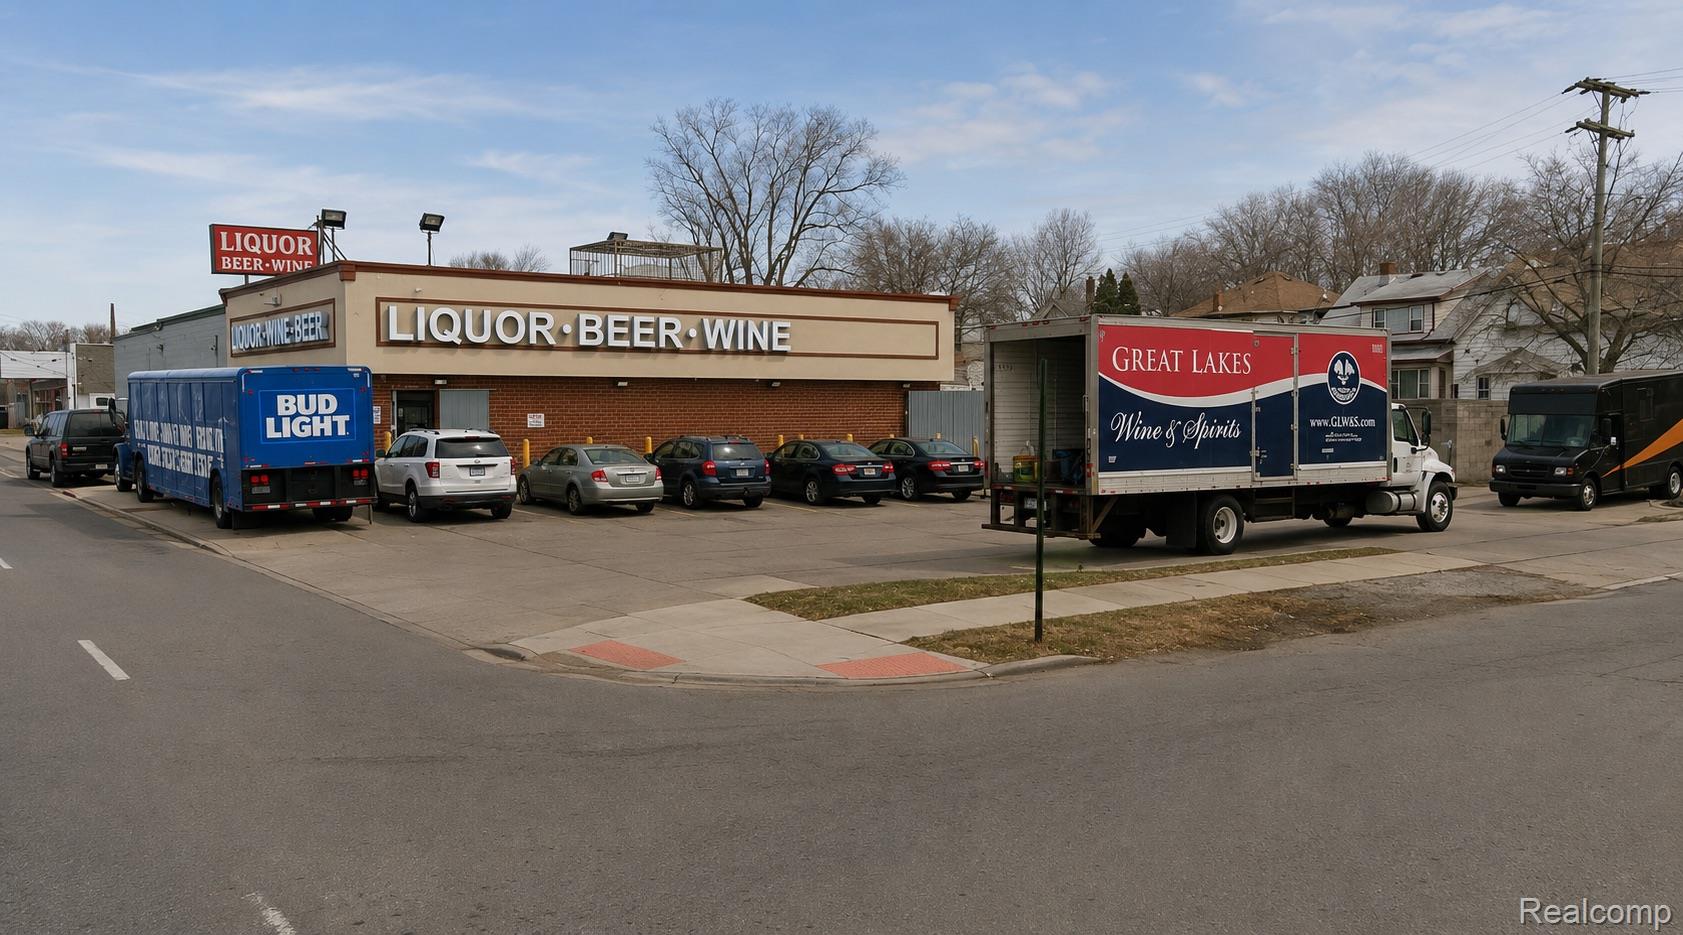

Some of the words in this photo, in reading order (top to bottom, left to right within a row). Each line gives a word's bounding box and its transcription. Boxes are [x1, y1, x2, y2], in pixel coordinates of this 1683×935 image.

[220, 231, 313, 256] LIQUOR
[221, 256, 263, 271] BEER
[231, 322, 262, 352] LIQUOR
[265, 317, 290, 346] WINE
[294, 311, 324, 341] BEER
[388, 305, 557, 345] LIQUOR
[578, 313, 684, 349] BEER
[702, 318, 792, 351] WINE
[1112, 346, 1184, 372] GREAT
[1191, 349, 1252, 375] LAKES
[276, 394, 338, 416] BUD
[266, 415, 350, 438] LIGHT
[1110, 411, 1162, 442] Wine
[1165, 419, 1182, 448] &
[1183, 412, 1242, 449] Spirits
[1309, 415, 1376, 428] www.GLW&S.com
